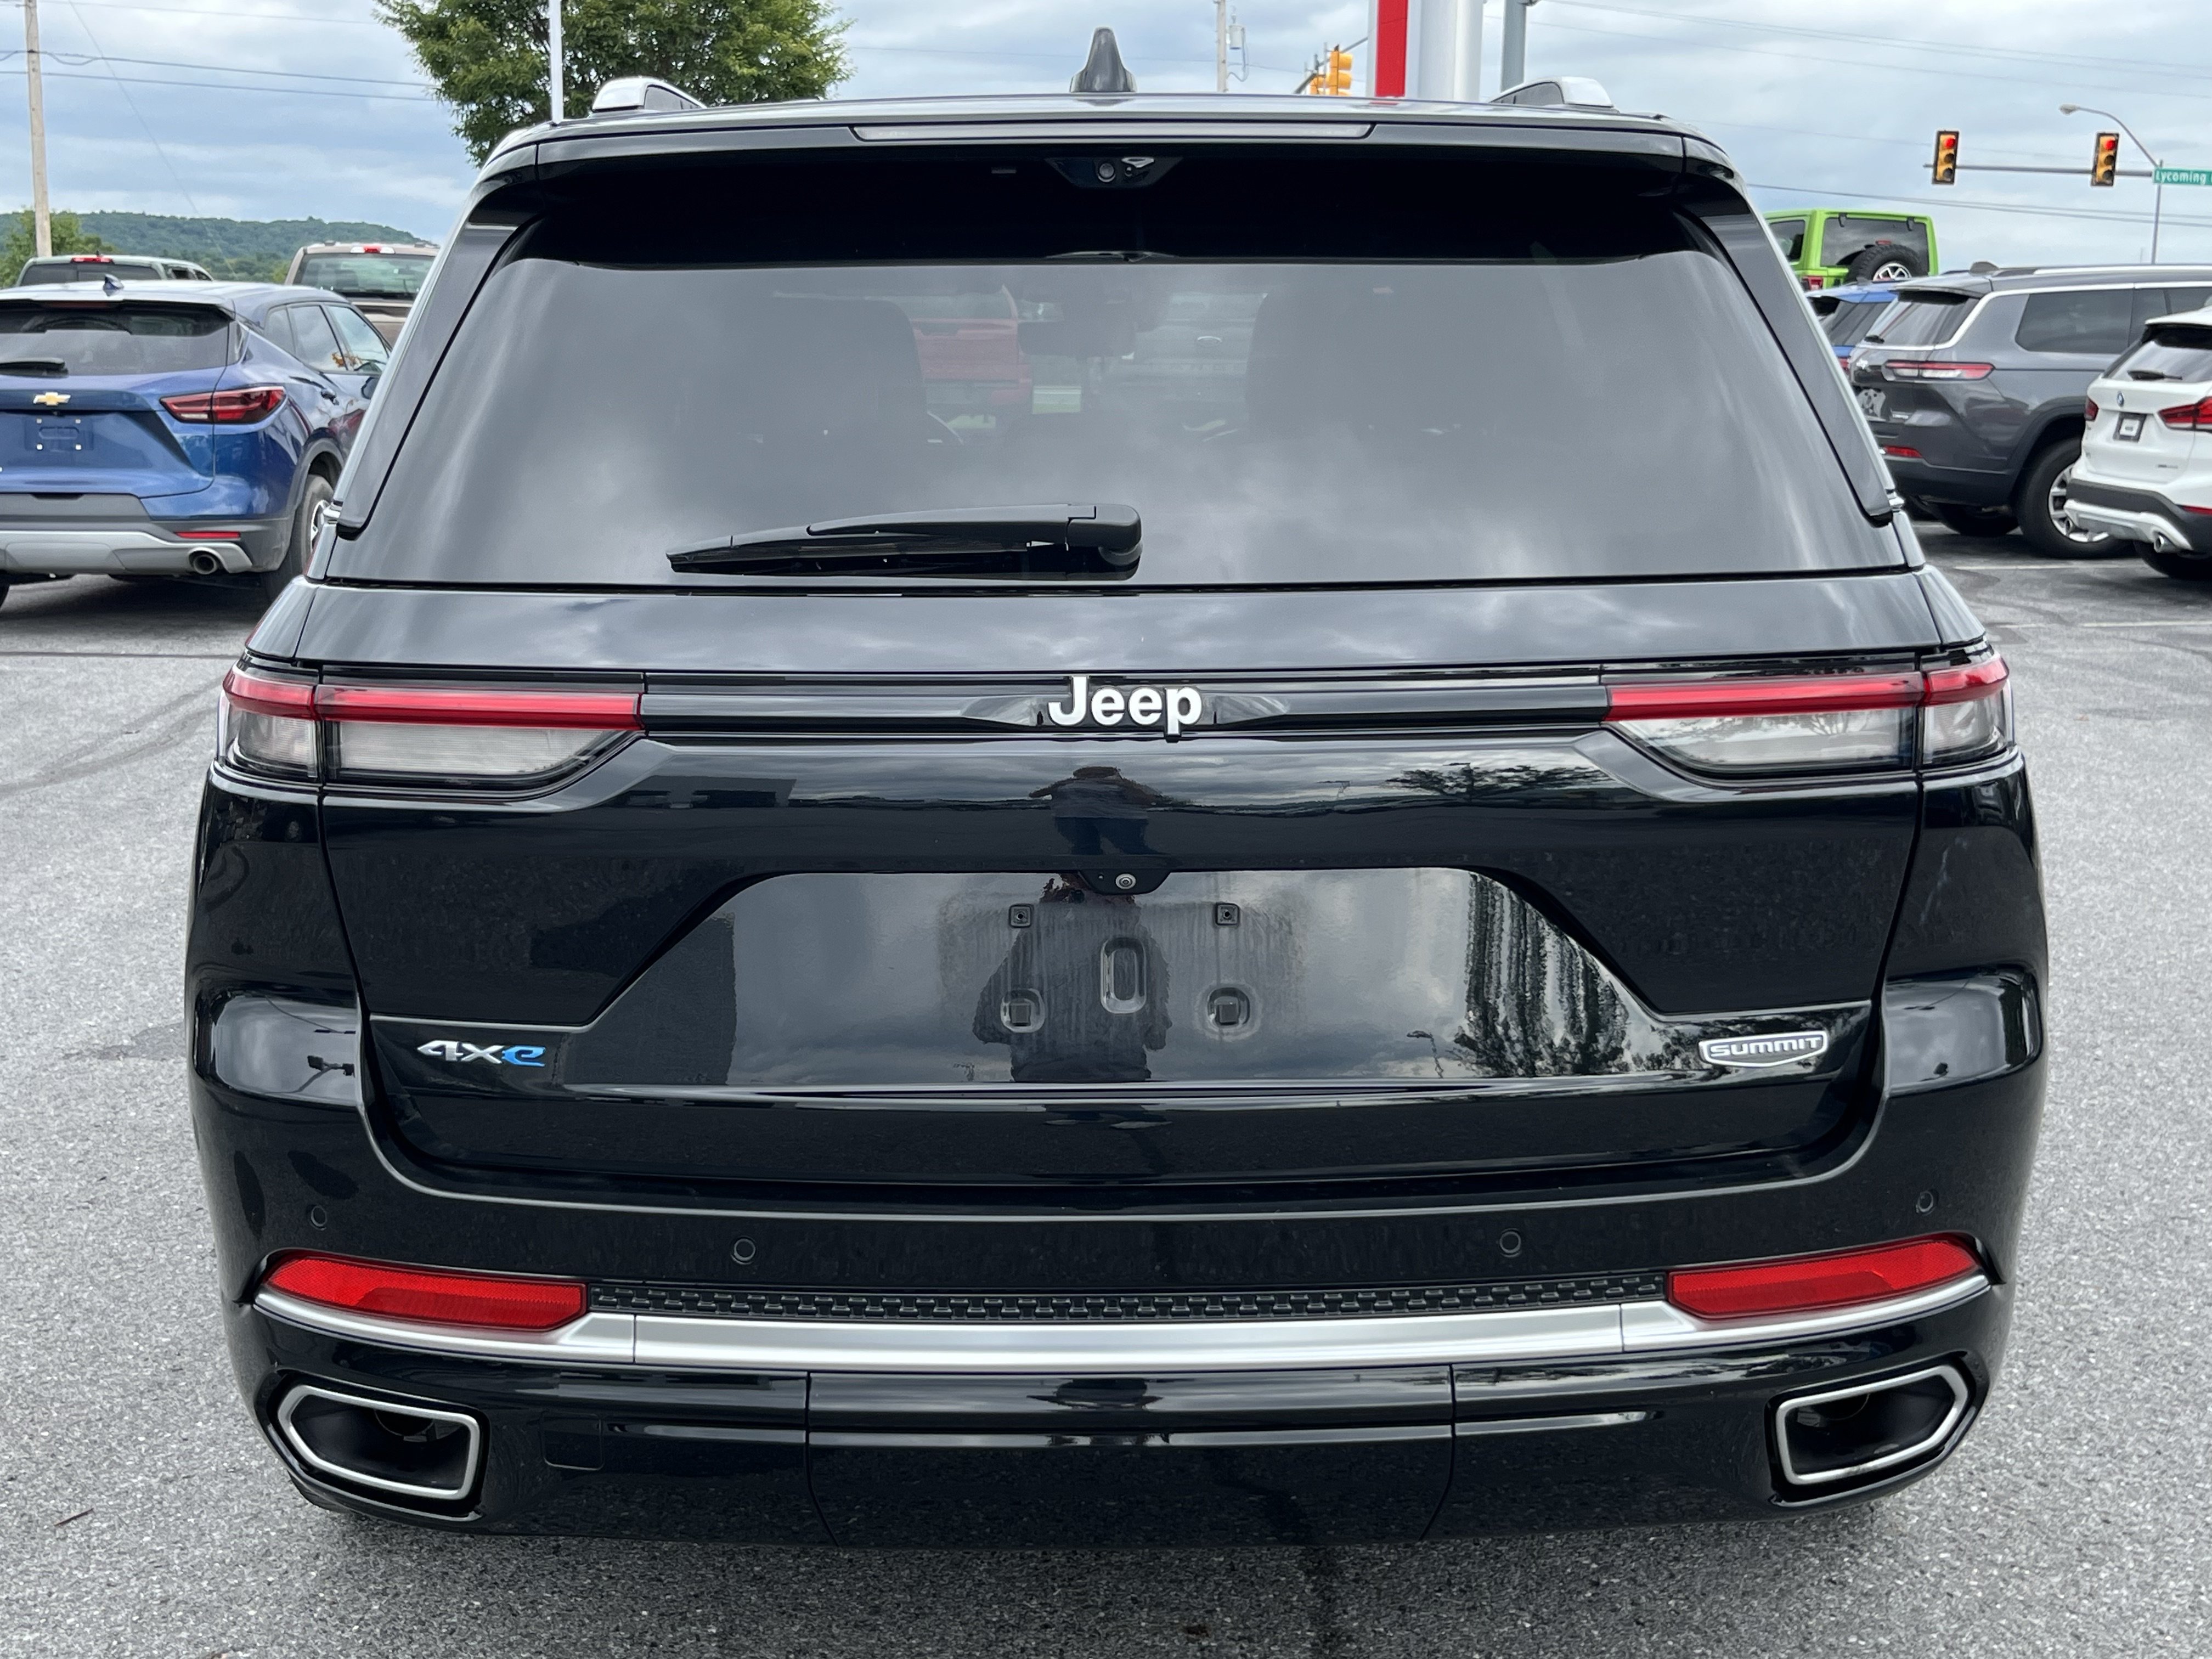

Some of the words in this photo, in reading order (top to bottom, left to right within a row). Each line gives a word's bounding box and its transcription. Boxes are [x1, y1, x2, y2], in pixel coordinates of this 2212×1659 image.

[2155, 170, 2206, 185] Lycoming
[1047, 675, 1203, 736] Jeep
[1710, 1036, 1822, 1057] SUMMIT
